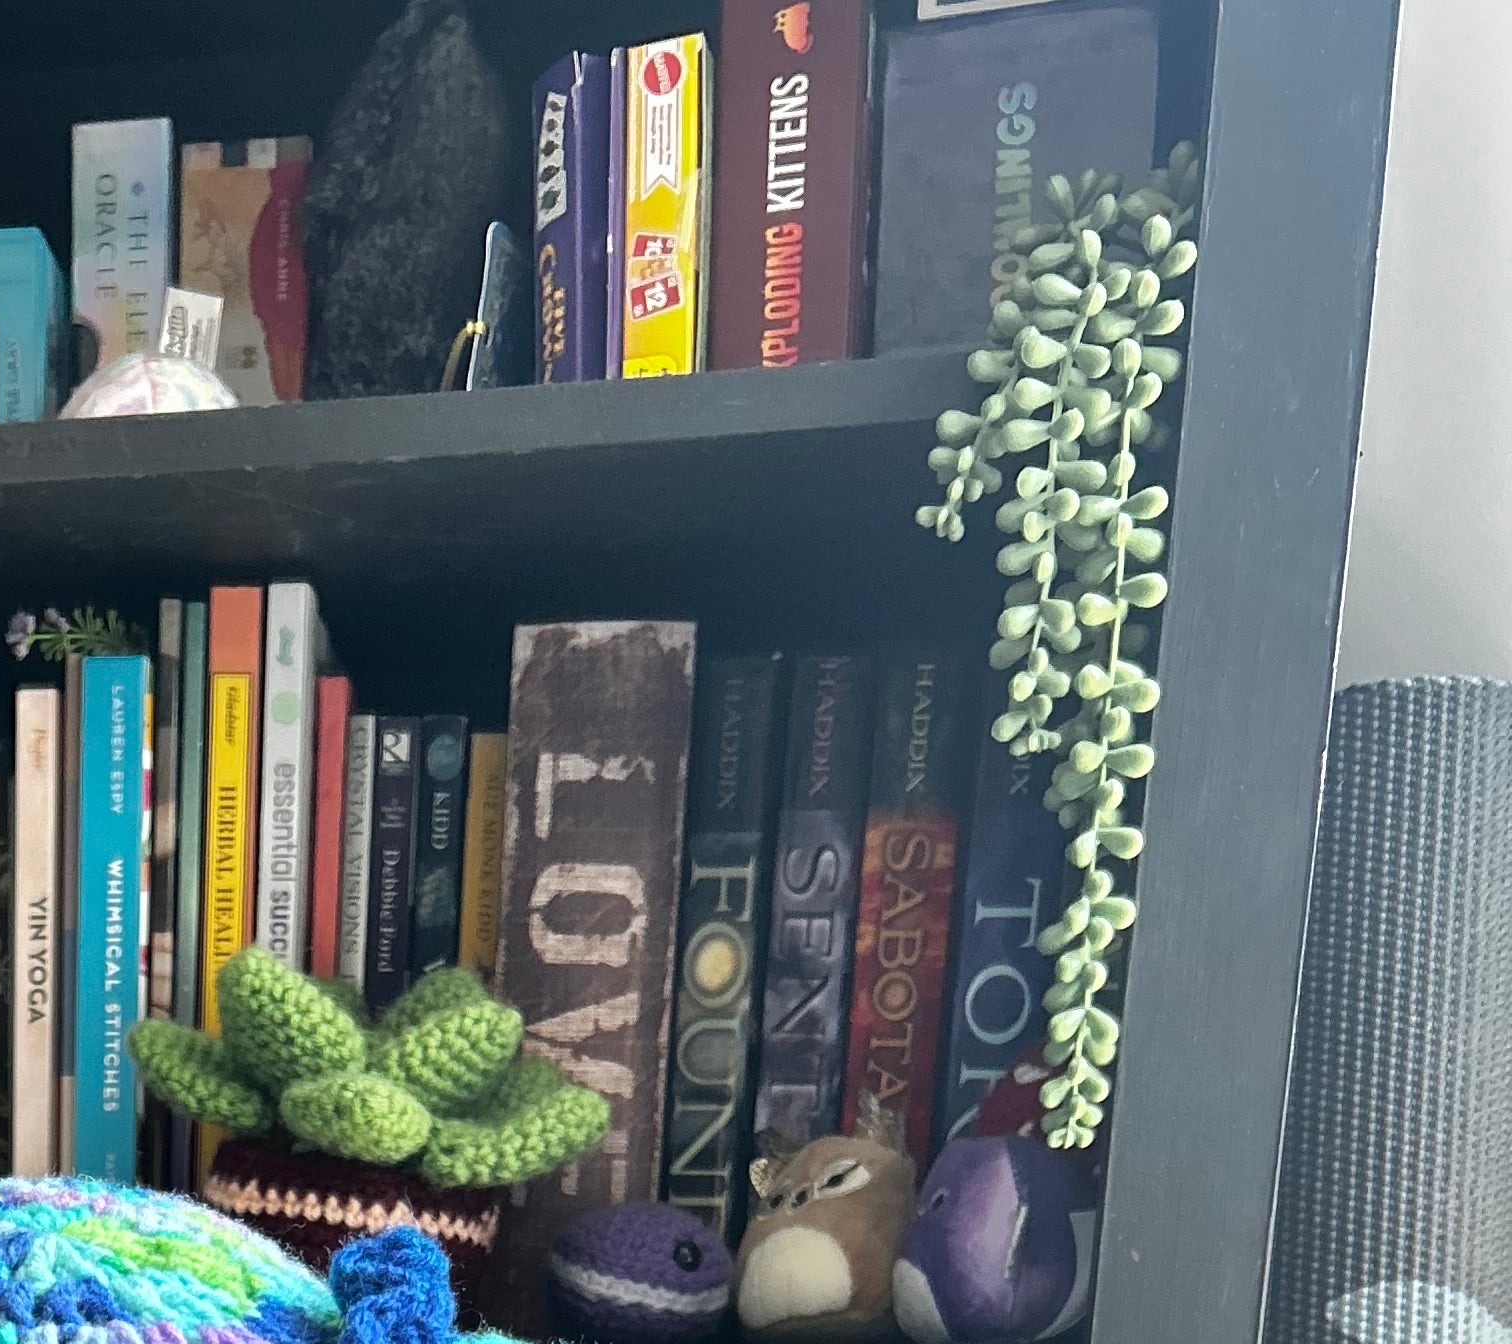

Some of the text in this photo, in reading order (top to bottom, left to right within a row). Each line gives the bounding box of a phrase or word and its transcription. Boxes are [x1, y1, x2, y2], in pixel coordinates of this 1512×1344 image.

[766, 74, 809, 214] KITTENS
[94, 174, 118, 301] ORACLE
[716, 678, 745, 809] HADDIX
[808, 657, 840, 798] HADDIX
[904, 662, 936, 792] HADDIX
[215, 785, 239, 881] HERBAL
[271, 762, 297, 881] essential
[343, 726, 367, 955] CRYSTAL VISIONS
[430, 790, 452, 850] KIDD
[26, 896, 49, 1025] YIN YOGA
[101, 683, 125, 1113] LAUREN ESPY WHIMSICAL STITCHES
[377, 848, 401, 975] Debbie Ford
